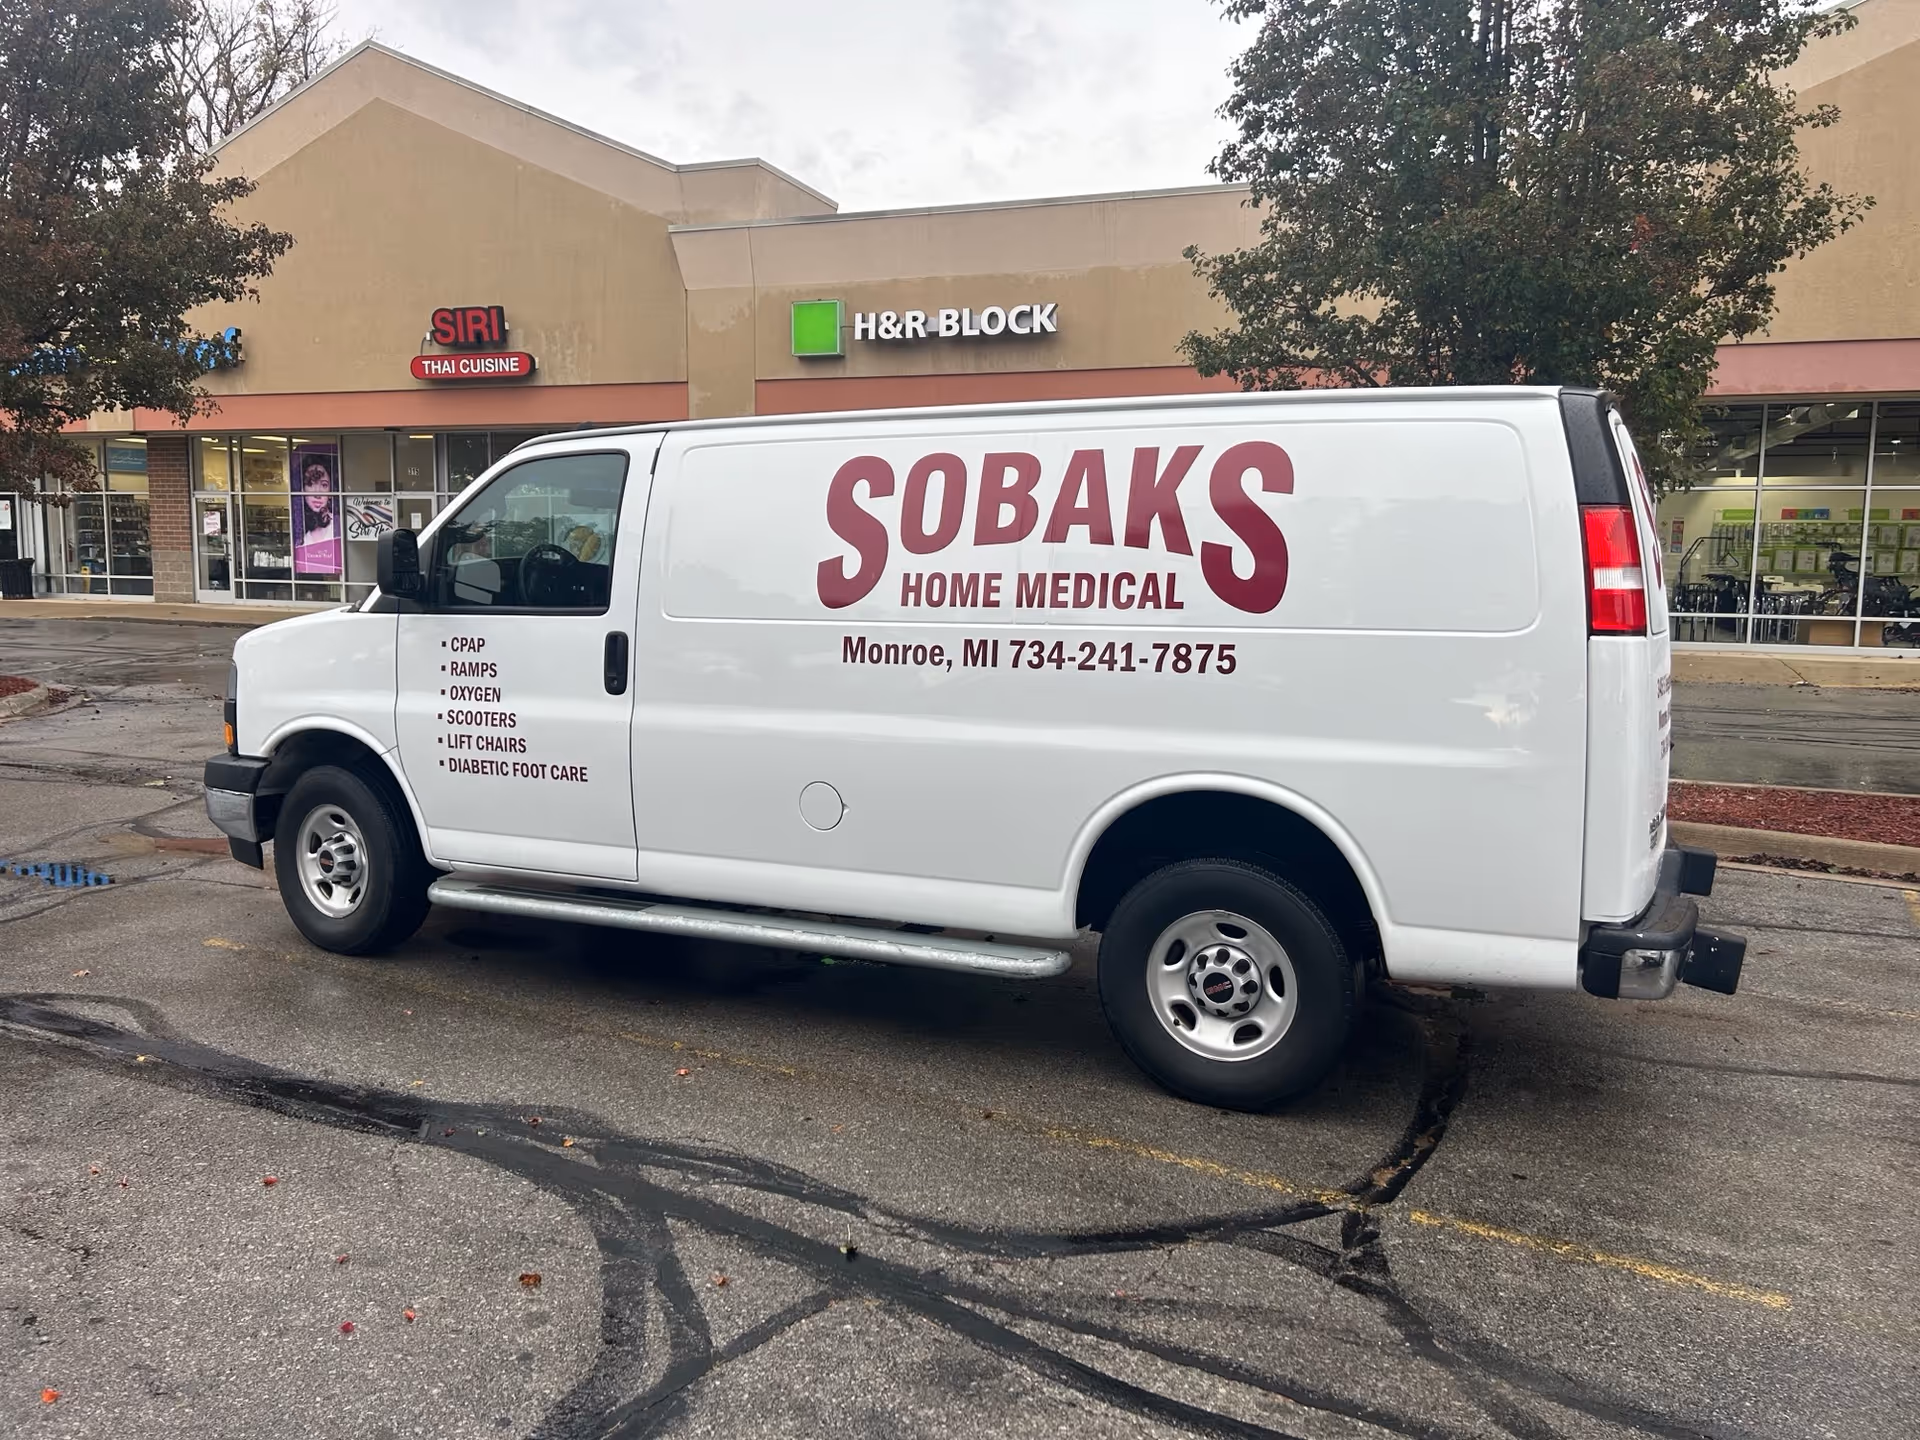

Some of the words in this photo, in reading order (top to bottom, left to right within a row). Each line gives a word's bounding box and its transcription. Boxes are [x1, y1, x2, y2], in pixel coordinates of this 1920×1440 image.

[432, 308, 501, 344] SIRI
[854, 309, 929, 341] H&R
[938, 303, 1058, 337] BLOCK
[422, 360, 455, 375] THAI
[459, 357, 519, 374] CUISINE
[816, 441, 1294, 614] SOBAKS
[901, 572, 1001, 608] HOME
[1015, 572, 1184, 610] MEDICAL
[450, 636, 486, 653] CPAP
[842, 635, 953, 673] Monroe,
[962, 638, 999, 669] MI
[1009, 640, 1238, 675] 734-241-7875
[450, 661, 498, 678] RAMPS
[450, 685, 501, 703] OXYGEN
[446, 709, 517, 728] SCOOTERS
[447, 733, 472, 750] LIFT
[476, 735, 527, 754] CHAIRS
[448, 757, 509, 776] DIABETIC
[512, 762, 547, 779] FOOT
[550, 764, 588, 782] CARE
